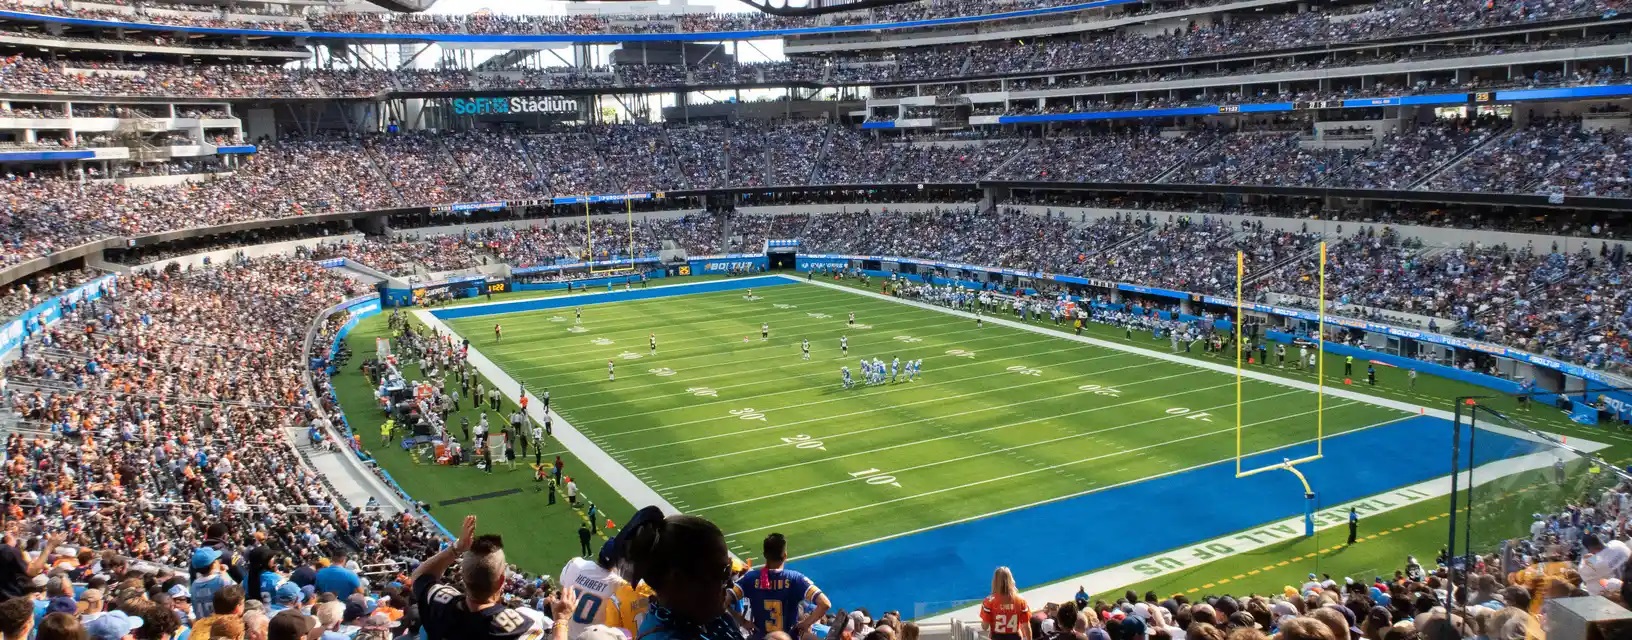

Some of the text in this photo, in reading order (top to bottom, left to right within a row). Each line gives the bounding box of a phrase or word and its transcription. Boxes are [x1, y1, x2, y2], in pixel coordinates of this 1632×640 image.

[453, 97, 577, 114] SoFi Stadium
[729, 407, 766, 420] 30
[780, 434, 824, 449] 20
[847, 467, 897, 485] 10
[1132, 489, 1430, 575] IT TAKES ALL OF US
[574, 574, 609, 593] HERBERT
[763, 599, 784, 632] 3
[994, 614, 1019, 633] 24
